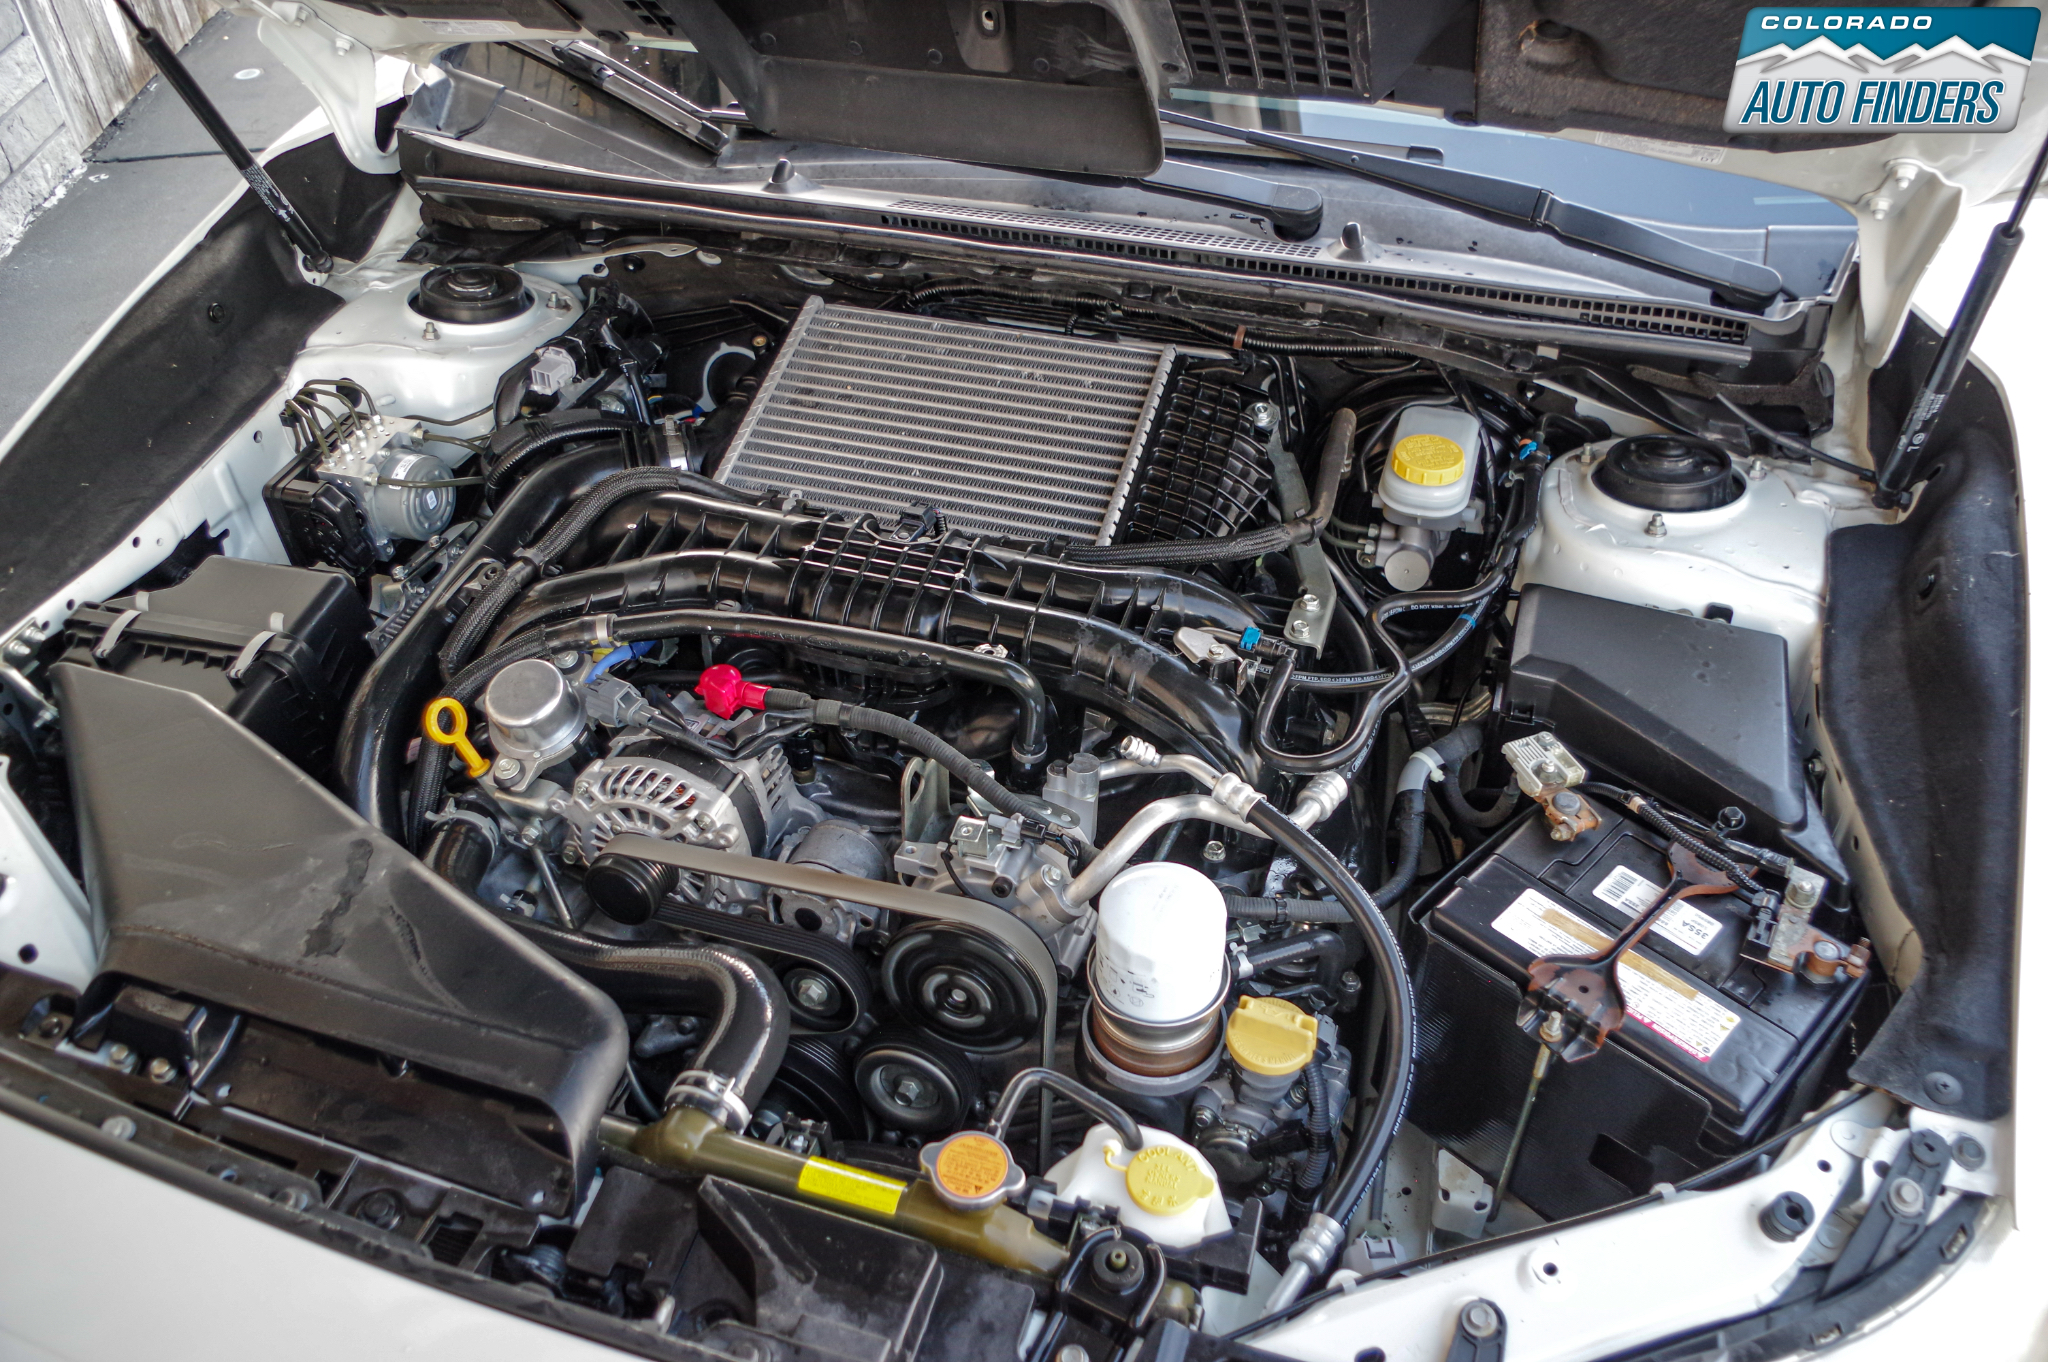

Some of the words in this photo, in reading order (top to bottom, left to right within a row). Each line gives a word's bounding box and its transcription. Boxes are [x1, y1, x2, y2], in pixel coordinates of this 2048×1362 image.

[1682, 919, 1709, 940] 35SA
[1137, 1146, 1199, 1172] COOLANT
[1155, 1163, 1171, 1172] SEE
[1145, 1177, 1178, 1189] MANUAL
